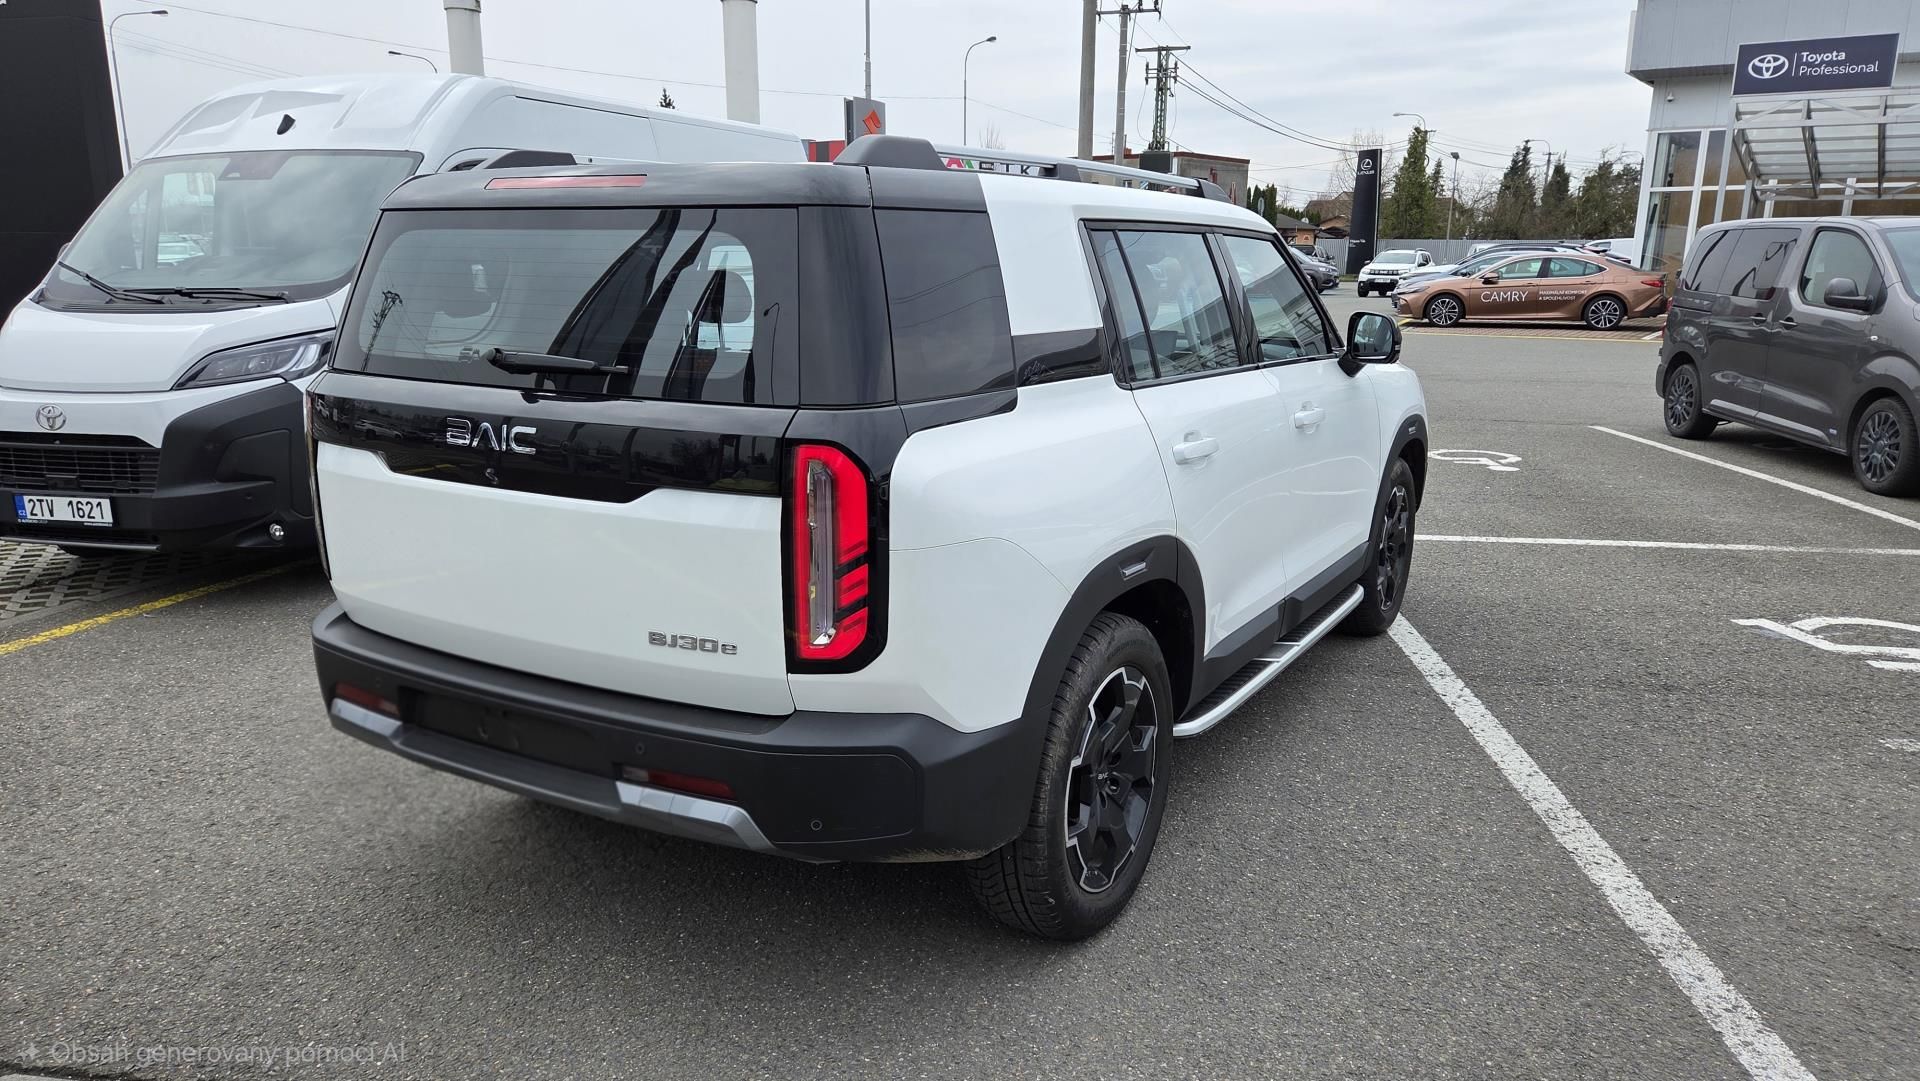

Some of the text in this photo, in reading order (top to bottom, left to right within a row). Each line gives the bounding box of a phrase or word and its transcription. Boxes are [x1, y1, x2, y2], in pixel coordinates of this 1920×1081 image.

[1801, 50, 1846, 65] Toyota
[1799, 61, 1880, 76] Professional
[1480, 290, 1529, 303] CAMRY
[446, 417, 537, 455] BAIC
[28, 499, 104, 520] 2TV 1621
[647, 629, 738, 656] BJ30e
